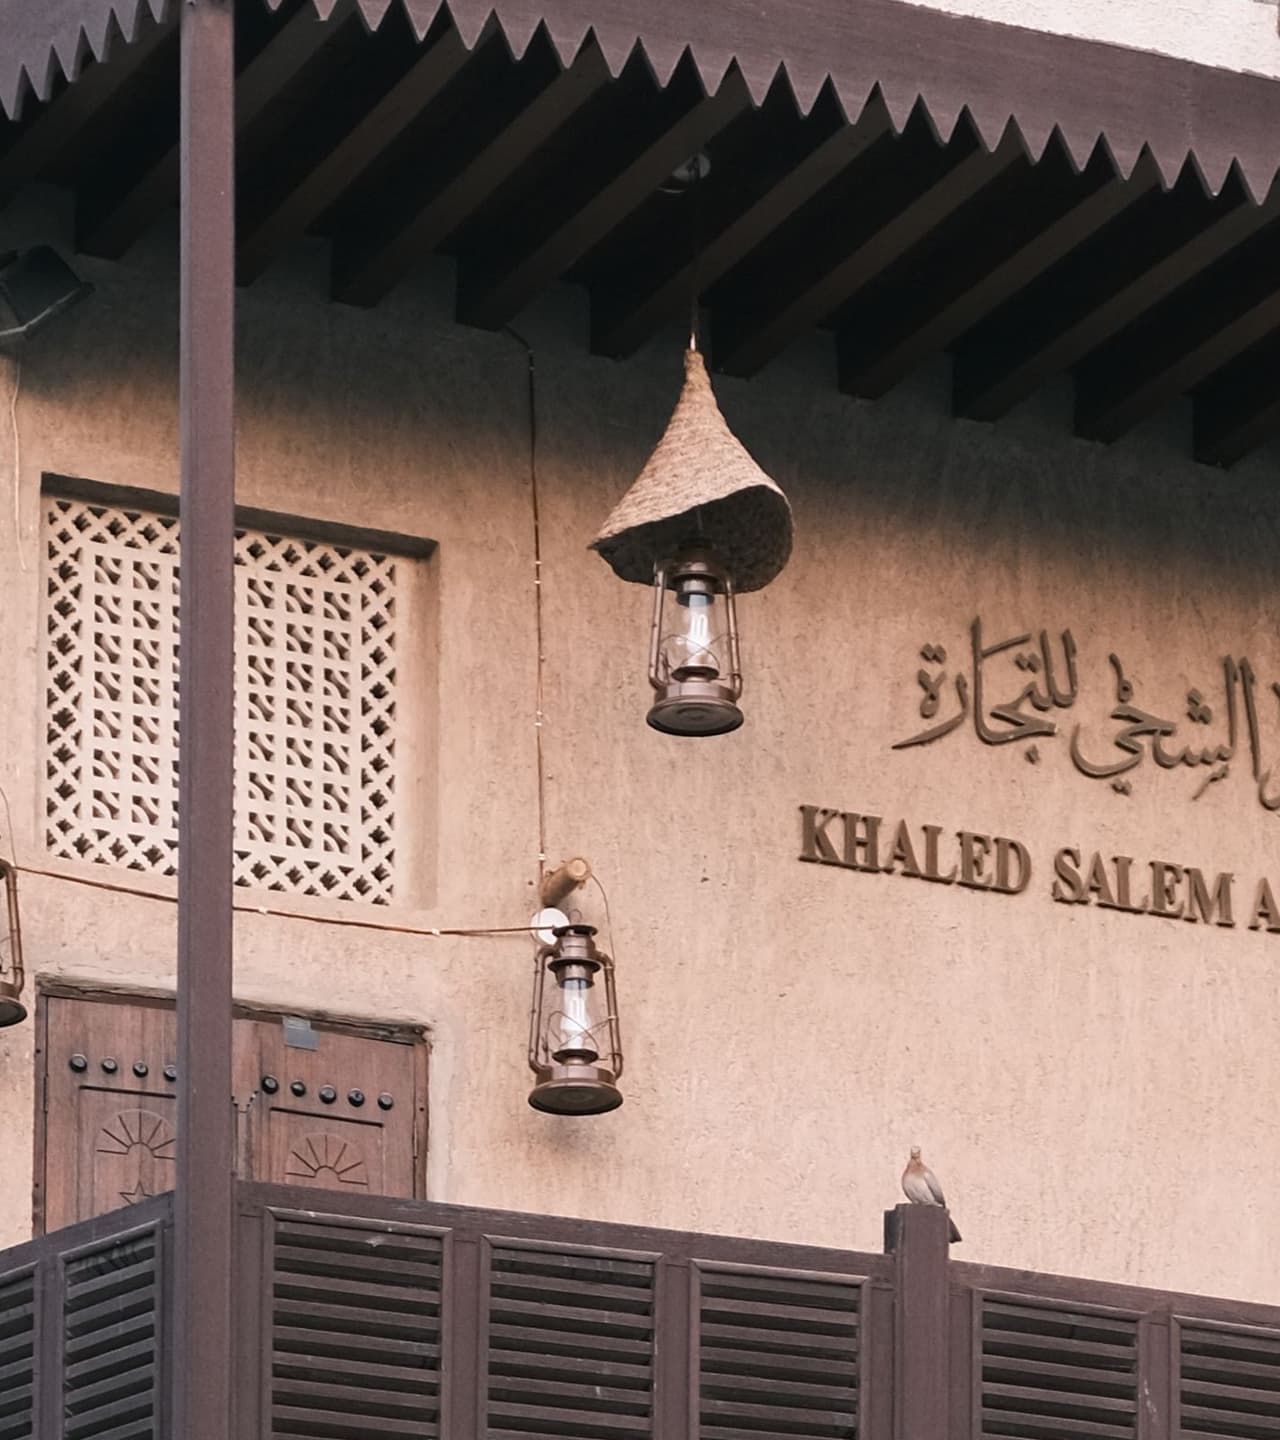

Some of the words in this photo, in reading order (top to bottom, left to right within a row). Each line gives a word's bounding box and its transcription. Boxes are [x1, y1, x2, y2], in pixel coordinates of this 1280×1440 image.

[891, 615, 1078, 764] للتجارة
[798, 804, 1033, 896] KHALED
[1051, 846, 1236, 928] SALEM
